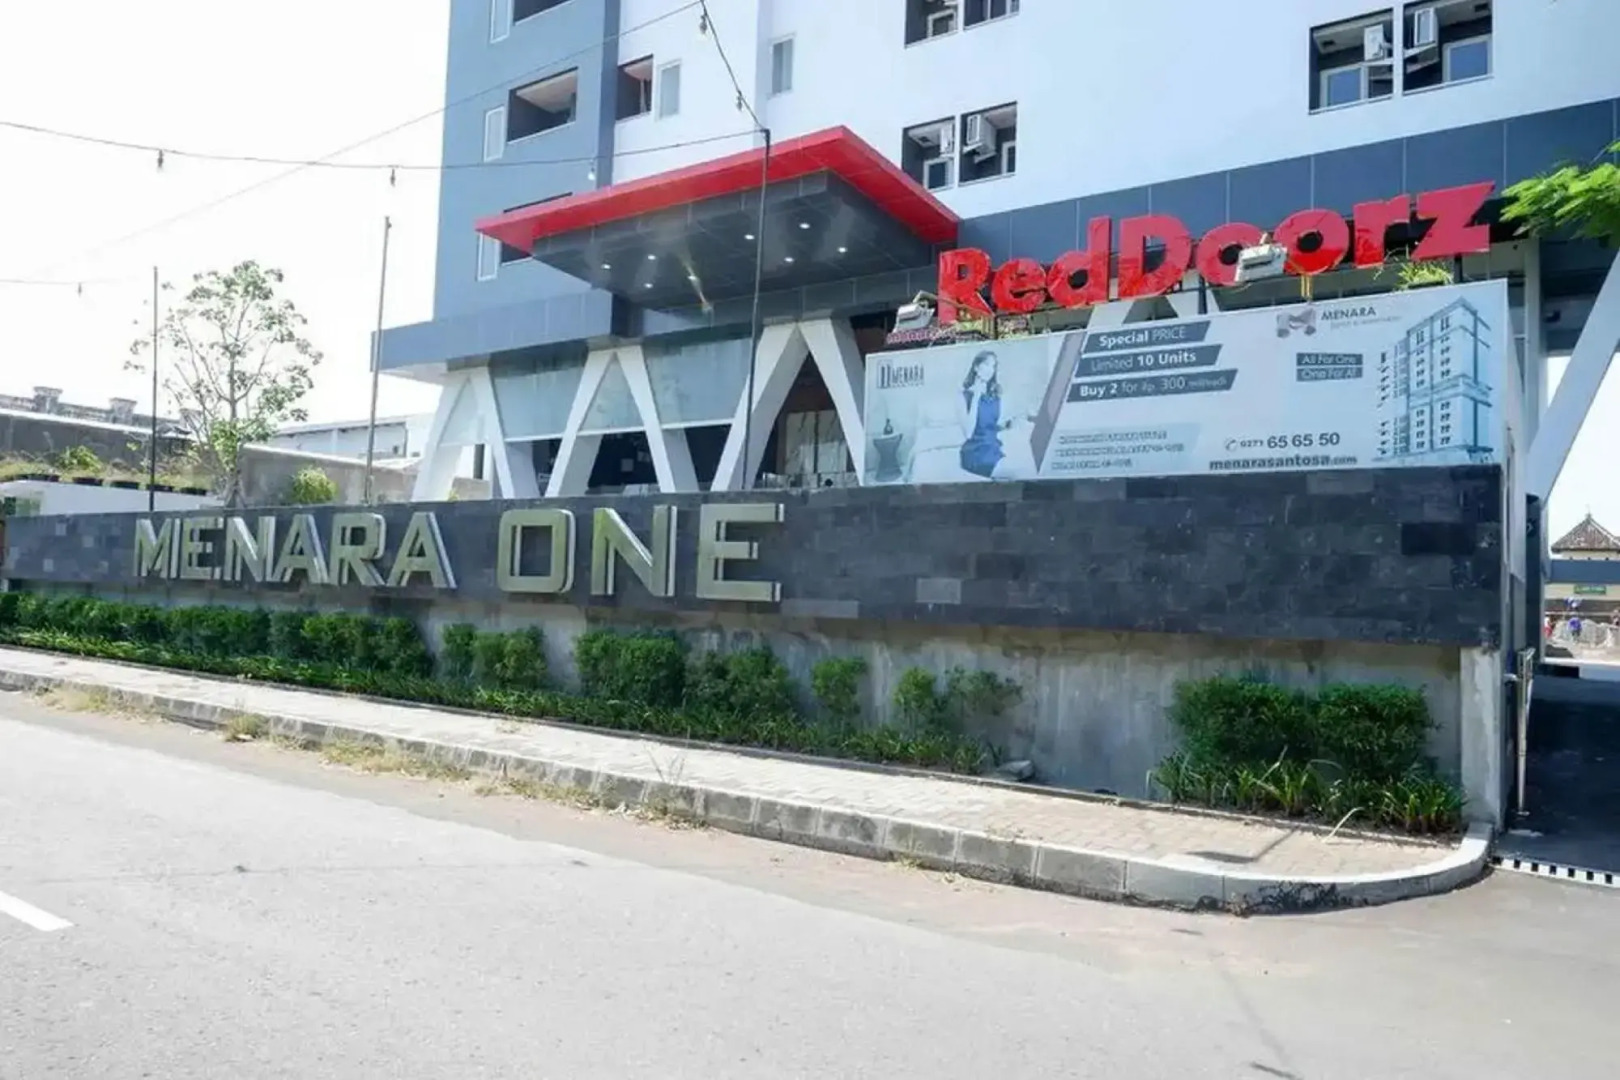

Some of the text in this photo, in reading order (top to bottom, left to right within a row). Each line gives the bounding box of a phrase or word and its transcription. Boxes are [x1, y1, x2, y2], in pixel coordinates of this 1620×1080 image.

[938, 180, 1496, 323] RedDoorz
[1321, 306, 1377, 320] MENARA
[1099, 326, 1186, 348] Special PRICE
[1091, 350, 1196, 371] Limited 10 Units
[1079, 384, 1106, 397] Buy
[1110, 383, 1118, 394] 2
[1122, 381, 1138, 392] for
[1160, 377, 1186, 390] 300
[1267, 435, 1288, 449] 65
[1292, 433, 1314, 447] 65
[1318, 431, 1341, 446] 50
[1209, 454, 1358, 471] menarasantosa.com
[133, 502, 785, 603] MENARA ONE
